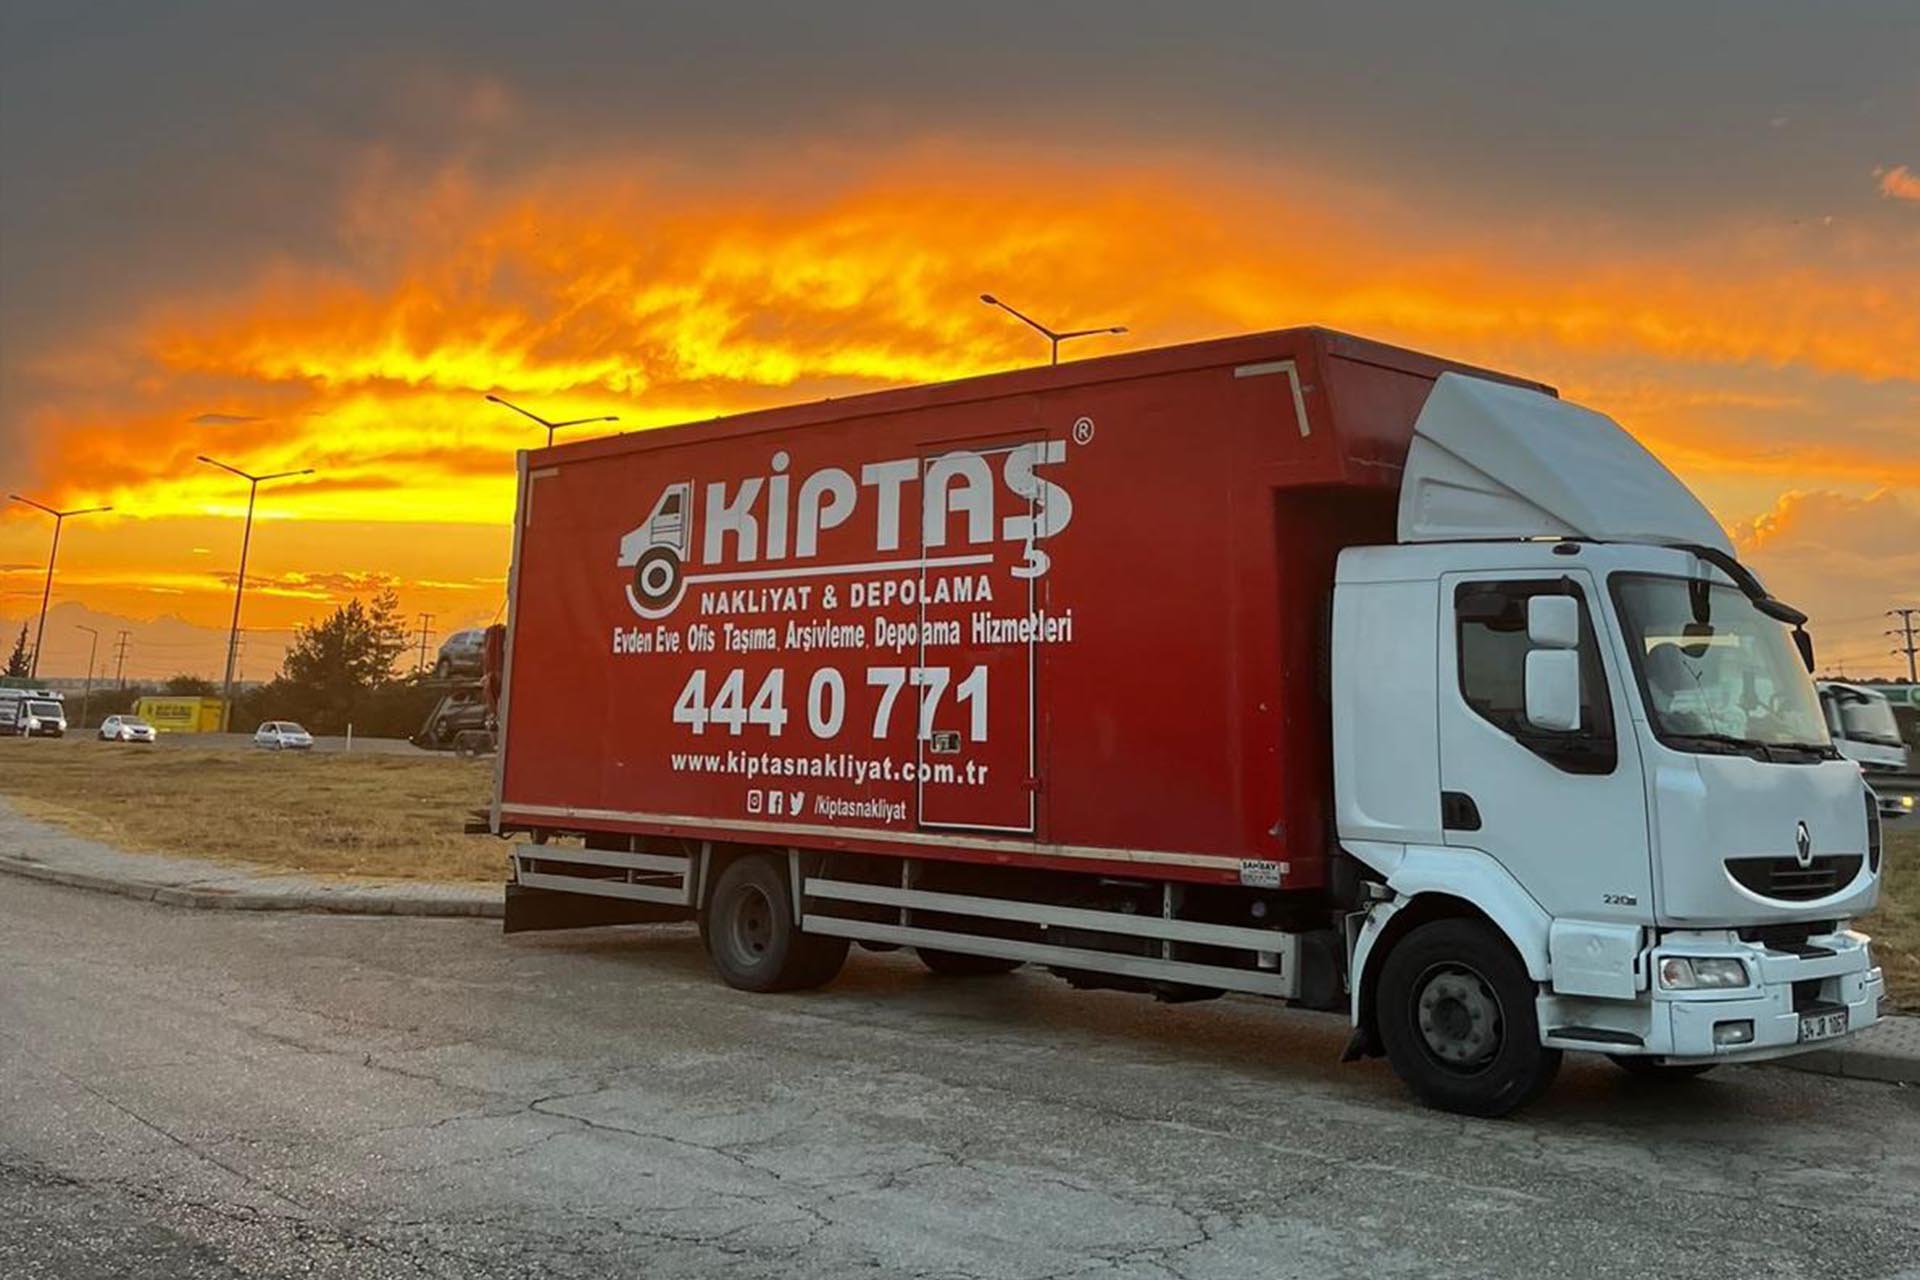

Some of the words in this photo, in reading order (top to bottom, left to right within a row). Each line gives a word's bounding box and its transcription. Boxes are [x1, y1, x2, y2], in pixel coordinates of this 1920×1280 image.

[822, 584, 838, 609] &
[851, 575, 993, 609] DEPOLAMA
[612, 627, 652, 653] Evden
[687, 624, 716, 652] Ofis
[672, 668, 788, 737] 444
[807, 667, 846, 739] 0
[866, 665, 988, 742] 771
[671, 751, 989, 785] www.kiptasnakliyat.com.tr
[814, 795, 907, 823] /kiptasnakliyat
